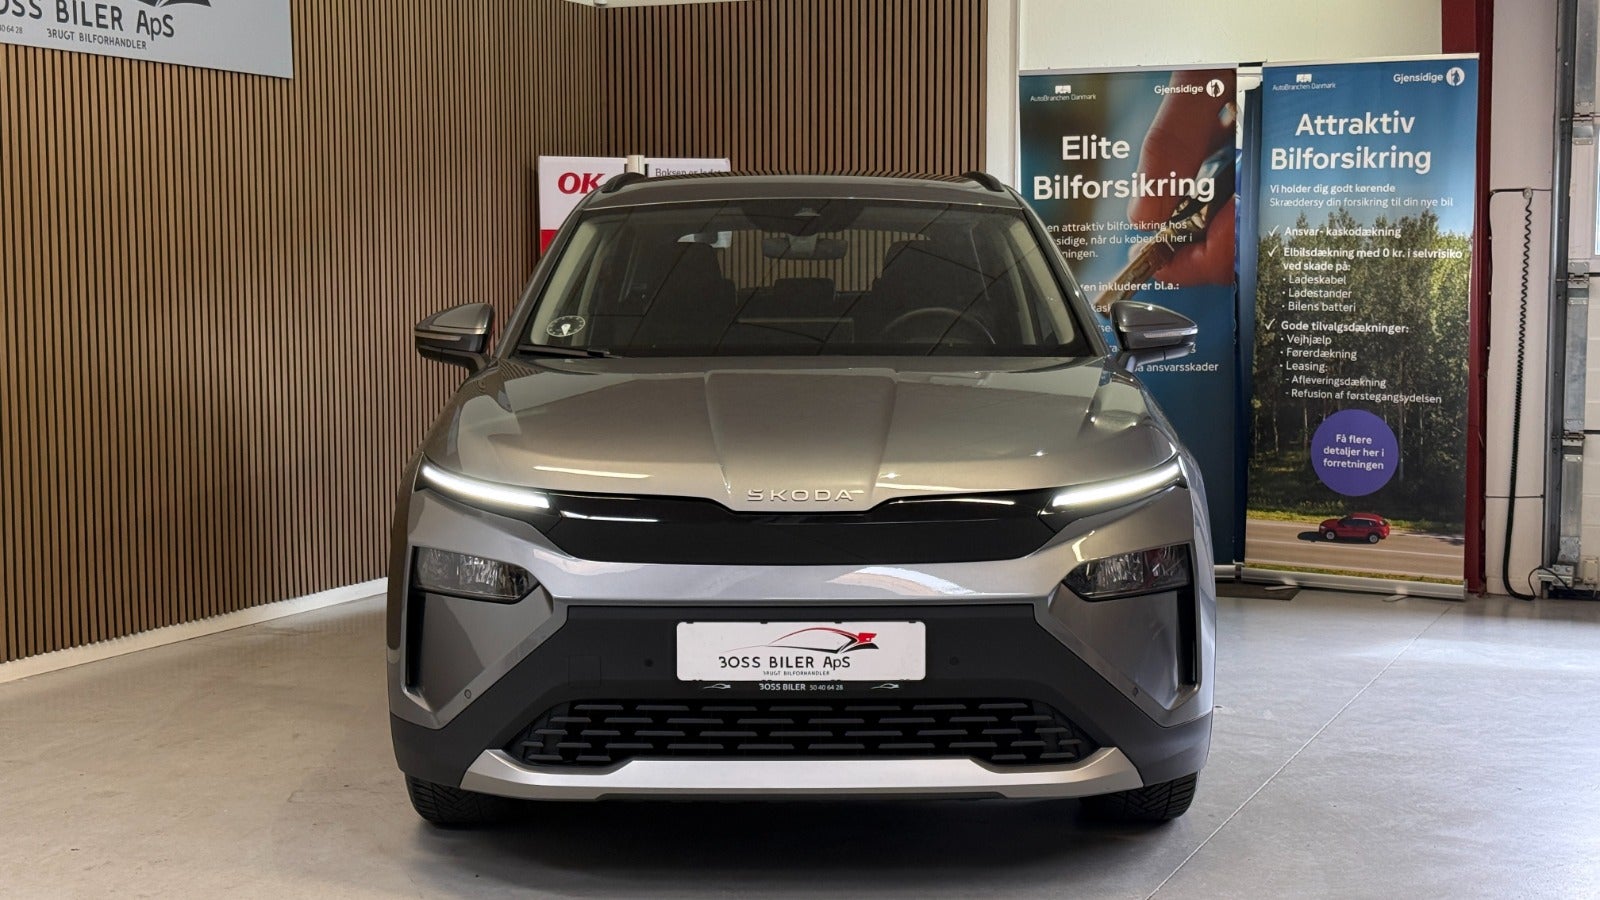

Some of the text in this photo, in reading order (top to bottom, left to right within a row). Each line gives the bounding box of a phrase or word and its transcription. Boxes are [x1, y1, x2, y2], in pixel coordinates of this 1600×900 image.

[56, 0, 123, 31] BILER
[136, 10, 175, 41] ApS
[79, 33, 147, 50] BILFORHANDLER
[1393, 73, 1444, 84] Gjensidige
[1154, 84, 1204, 96] Gjensidige
[1272, 83, 1310, 91] AutoBranchen
[1030, 93, 1096, 102] AutoBranchen Danmark
[1295, 110, 1415, 136] Attraktiv
[1062, 134, 1130, 160] Elite
[1271, 145, 1431, 174] Bilforsikring
[558, 172, 605, 194] OK
[1034, 172, 1215, 202] Bilforsikring
[1270, 183, 1396, 195] Vi holder dig godt kørende
[1270, 197, 1454, 209] Skræddersy din forsikring til din nye bil
[1062, 222, 1104, 232] attraktiv
[1107, 220, 1166, 232] bilforsikring
[1169, 221, 1188, 230] hos
[1326, 226, 1401, 238] kaskodækning
[1055, 236, 1088, 247] sidige,
[1091, 235, 1107, 244] når
[1110, 235, 1122, 244] du
[1125, 234, 1154, 244] køber
[1156, 234, 1168, 242] bil
[1171, 234, 1187, 242] her
[1284, 248, 1462, 260] Elbilsdækning med 0 kr. i selvrisiko
[1284, 262, 1350, 273] ved skade på:
[1288, 275, 1346, 285] Ladeskabel
[1099, 282, 1152, 292] inkluderer
[1154, 281, 1180, 290] bl.a.:
[1288, 289, 1352, 298] Ladestander
[1288, 302, 1356, 312] Bilens batteri
[1281, 320, 1409, 334] Gode tilvalgsdækninger:
[1286, 335, 1332, 346] Vejhjælp
[1286, 348, 1358, 360] Førerdækning
[1146, 362, 1219, 372] ansvarsskader
[1286, 361, 1328, 373] Leasing:
[1291, 375, 1386, 389] Afleveringsdækning
[1291, 389, 1442, 404] Refusion af førstegangsydelsen
[1336, 433, 1372, 444] Få flere
[1324, 446, 1384, 457] detaljer her i
[1323, 458, 1384, 470] forretningen
[770, 656, 814, 668] BILER
[823, 656, 850, 670] ApS
